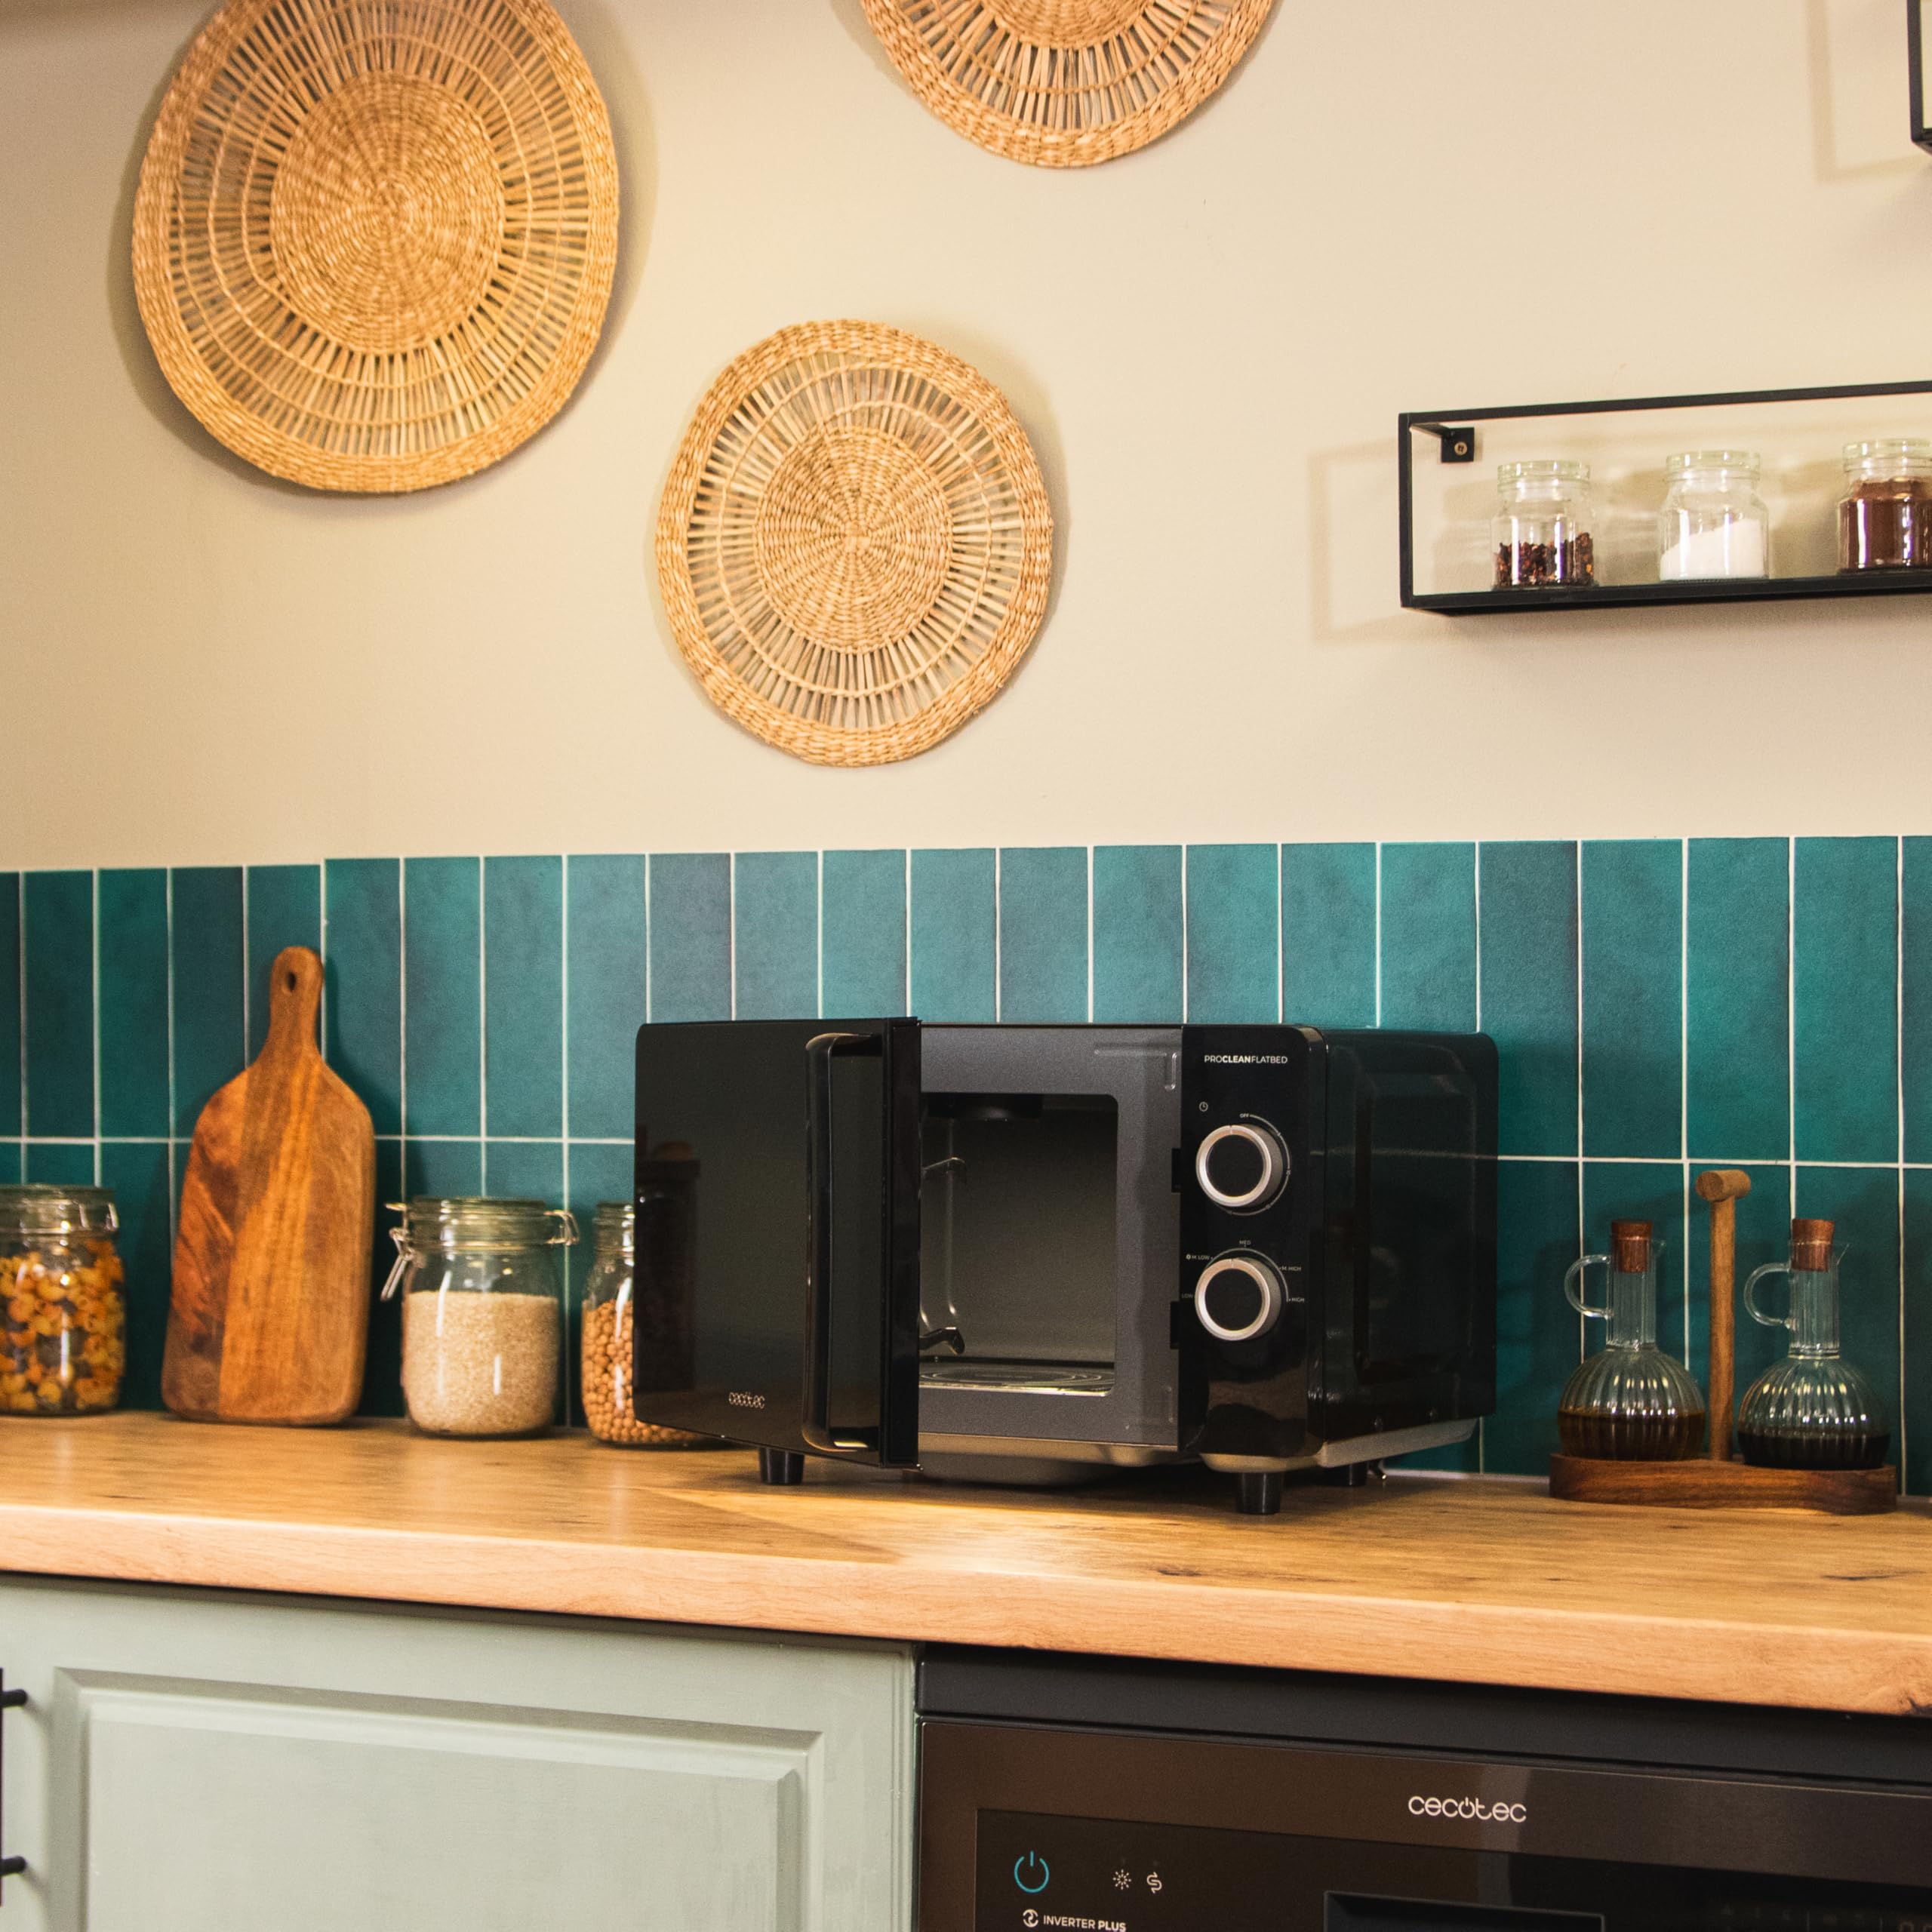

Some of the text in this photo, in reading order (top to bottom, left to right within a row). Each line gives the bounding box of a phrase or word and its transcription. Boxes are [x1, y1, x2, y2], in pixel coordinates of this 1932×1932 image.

[1204, 1055, 1288, 1064] PROCLEANFLATBED
[1408, 1796, 1527, 1823] cecotec
[1044, 1915, 1127, 1932] INVERTER PLUS
